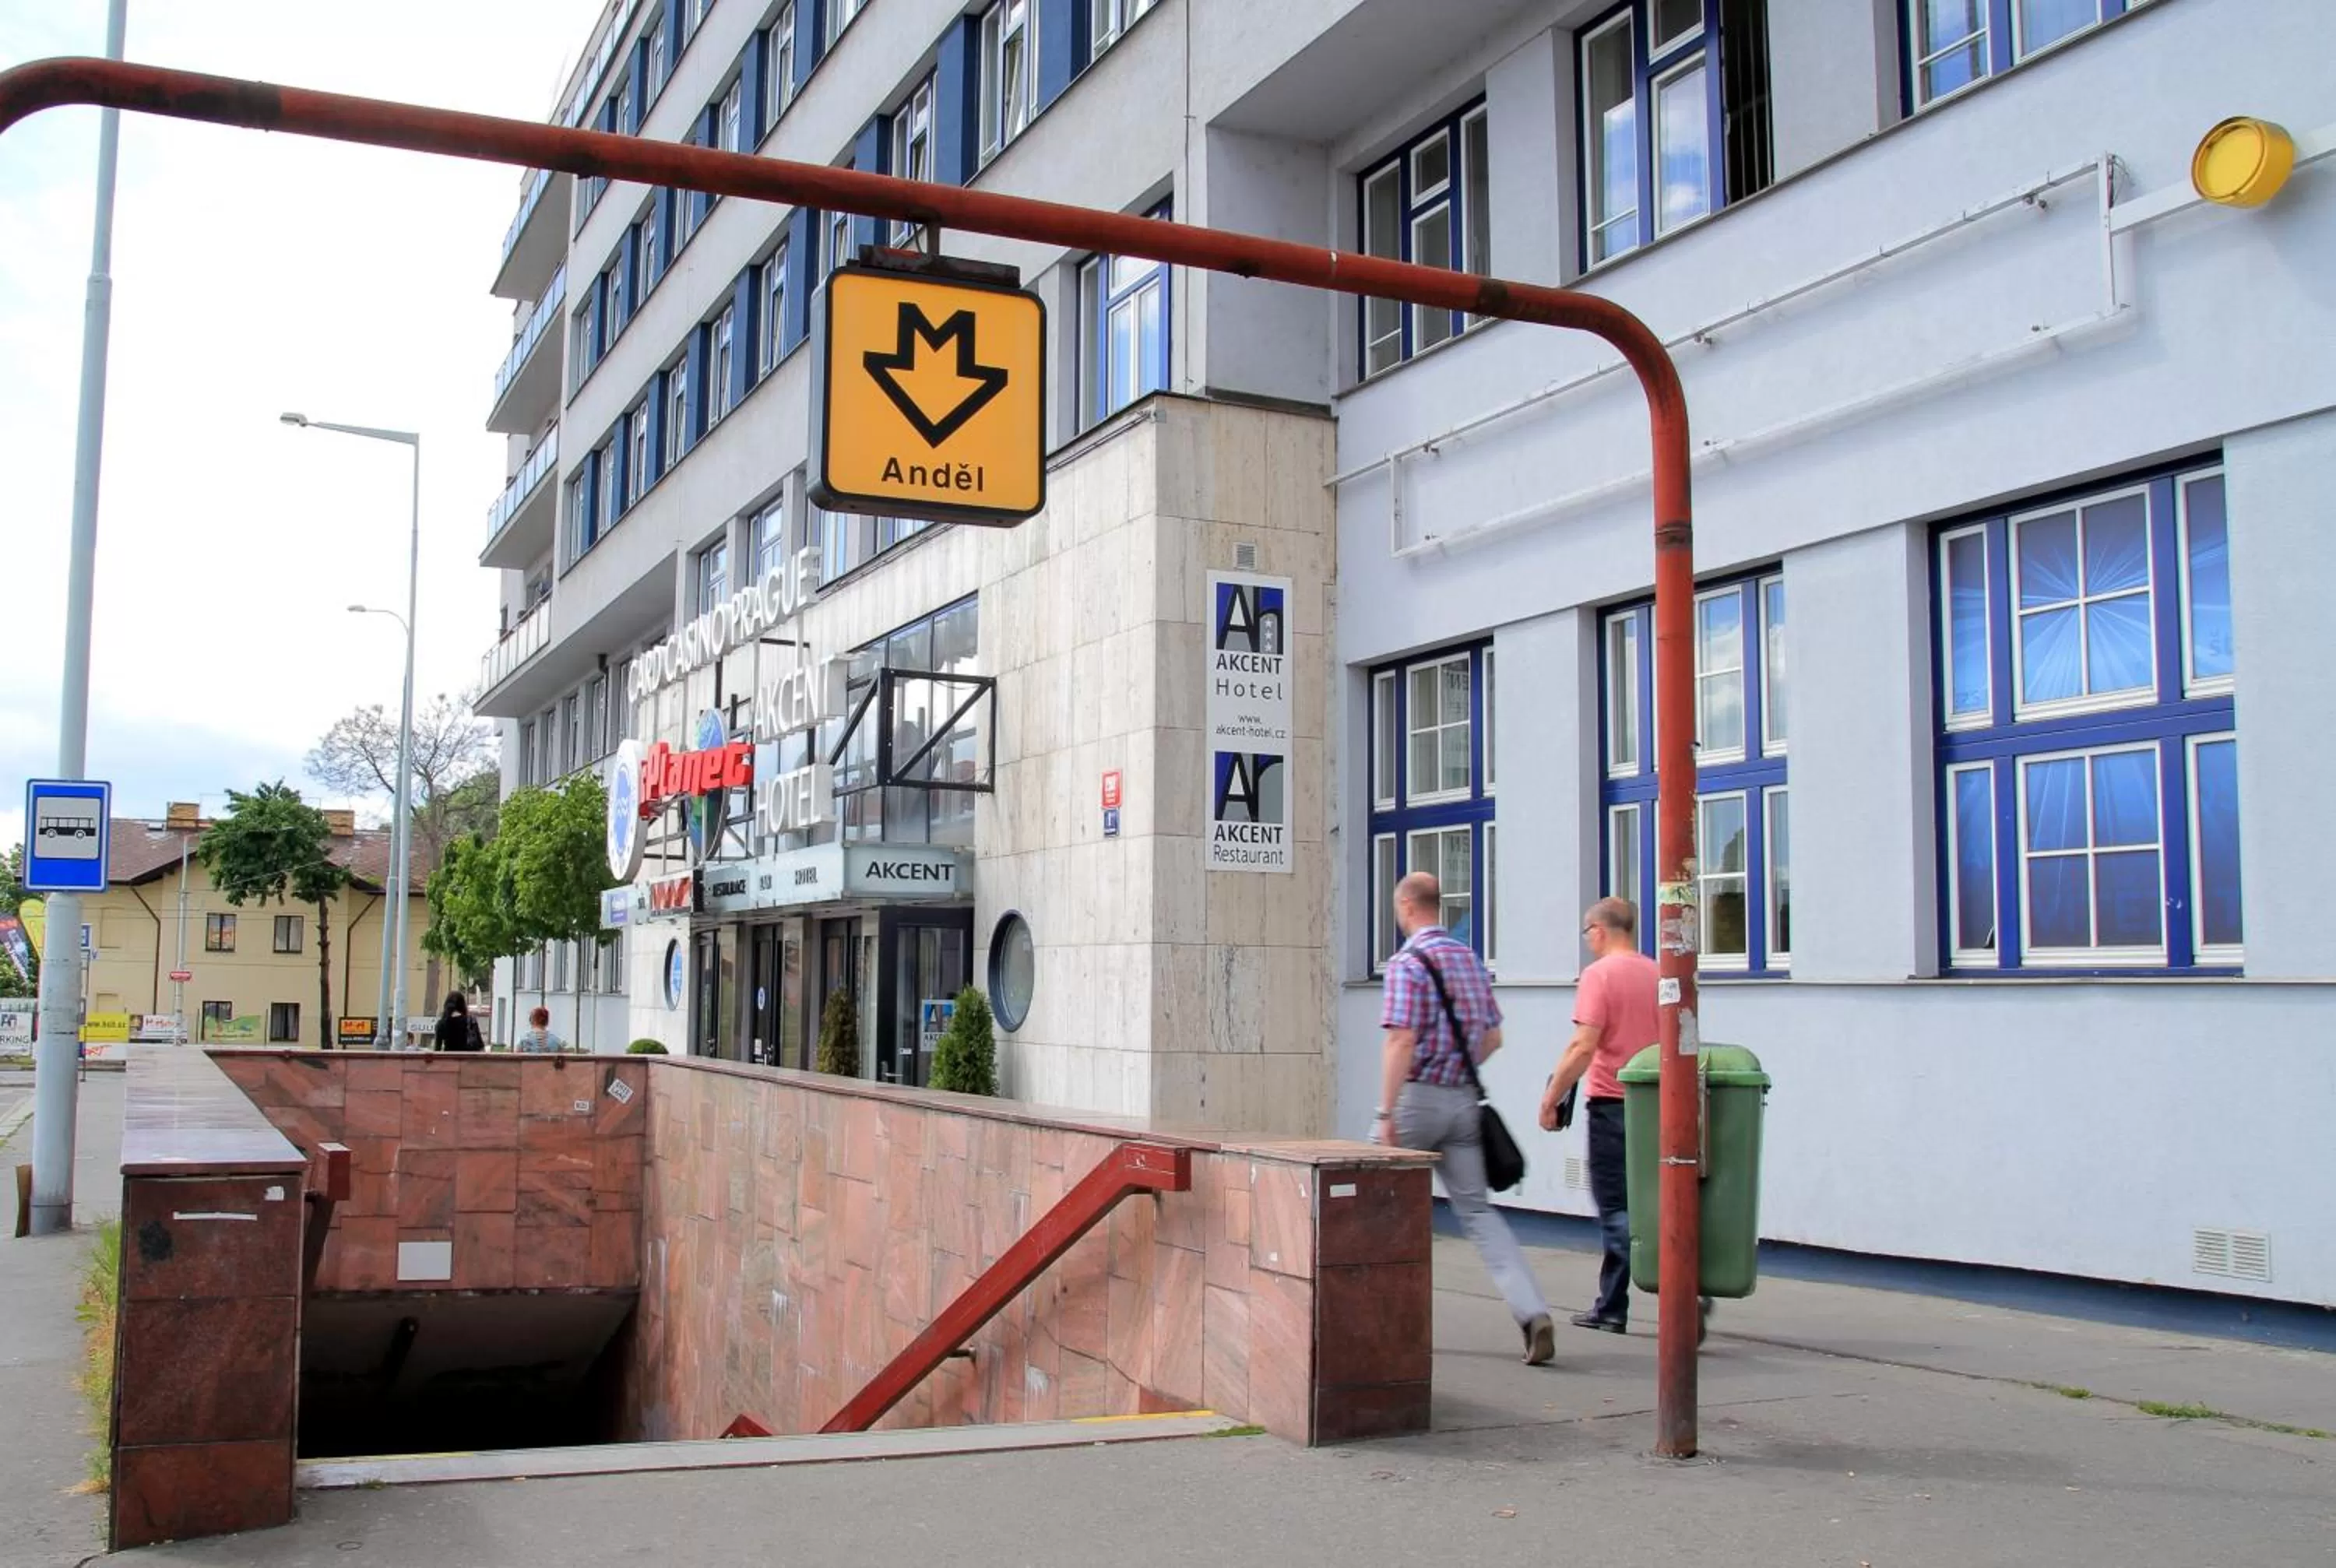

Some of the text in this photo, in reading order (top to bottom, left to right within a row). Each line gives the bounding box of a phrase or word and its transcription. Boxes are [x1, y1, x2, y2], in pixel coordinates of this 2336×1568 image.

[881, 457, 984, 492] Anděl
[628, 547, 810, 702] CARD CASINO PRAGUE
[1215, 653, 1283, 674] AKCENT
[754, 656, 835, 744] AKCENT
[1216, 678, 1282, 701] Hotel
[1215, 724, 1286, 740] akcent-hotel.cz
[755, 763, 821, 837] HOTEL
[1214, 823, 1283, 845] AKCENT
[1213, 844, 1284, 865] Restaurant
[865, 860, 955, 881] AKCENT
